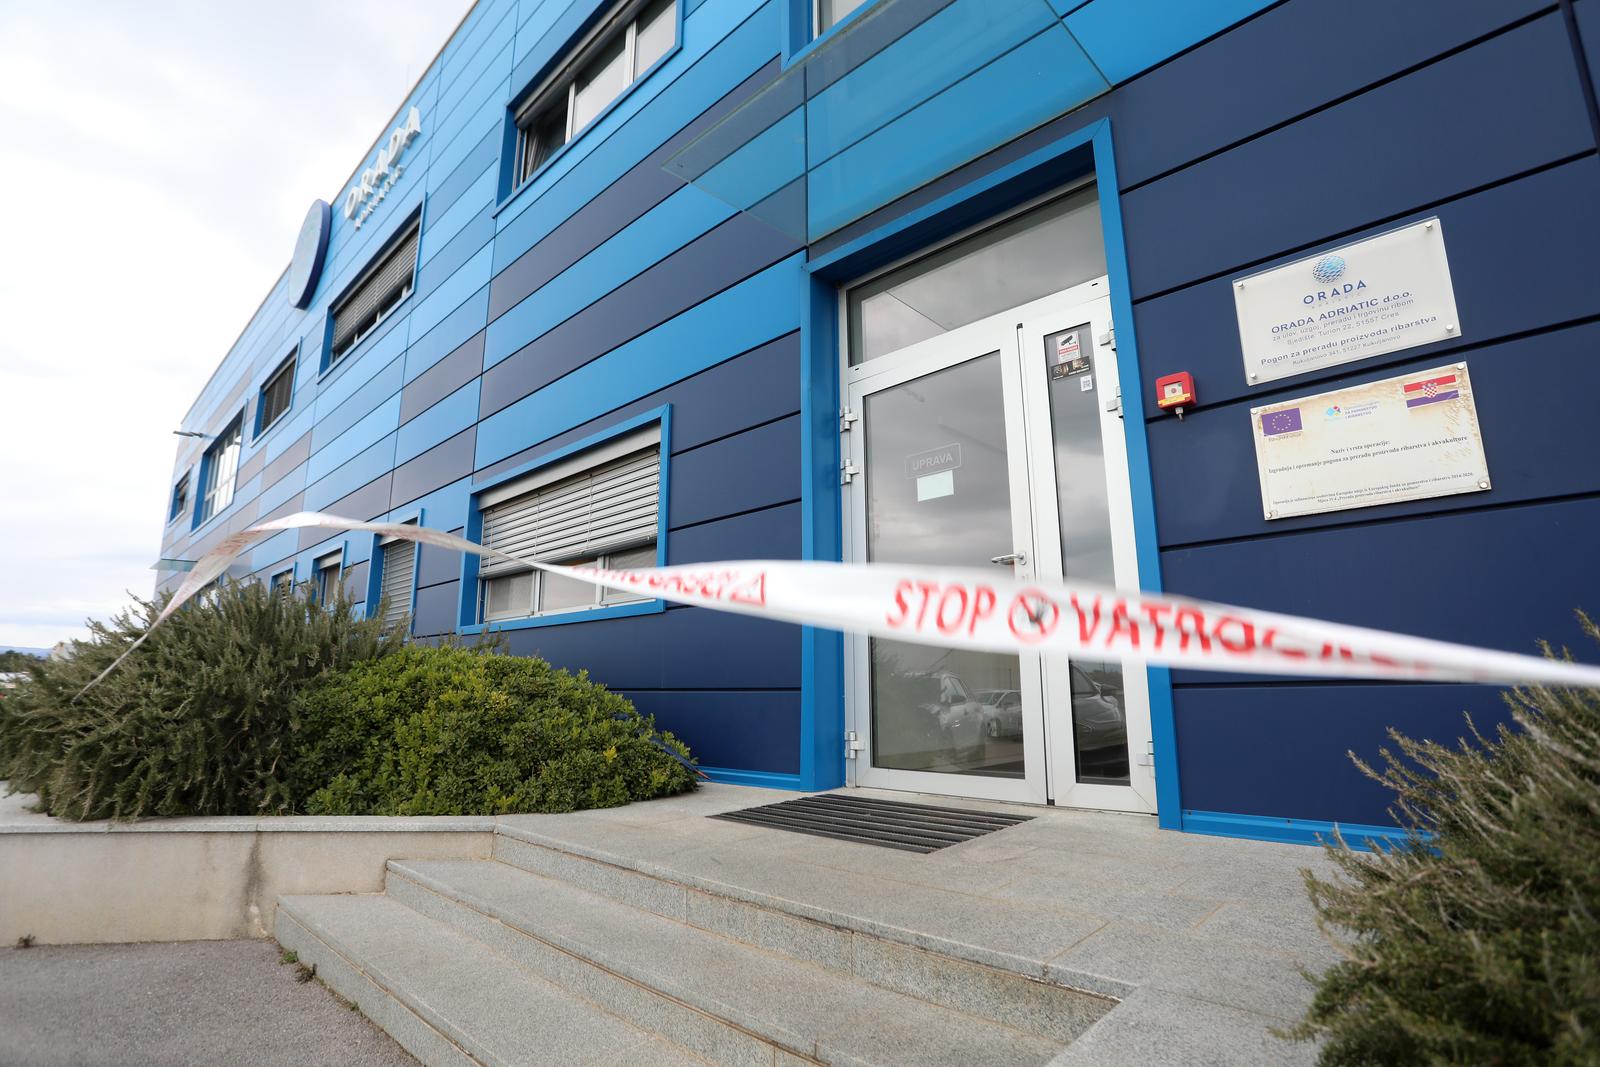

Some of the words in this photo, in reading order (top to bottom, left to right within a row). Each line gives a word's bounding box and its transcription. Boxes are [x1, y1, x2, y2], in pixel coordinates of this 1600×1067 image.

[1303, 280, 1367, 304] ORADA
[1271, 316, 1315, 334] ORADA
[1319, 298, 1379, 321] ADRIATIC
[1383, 291, 1413, 303] d.o.o.
[1323, 314, 1352, 328] preradu
[1358, 305, 1390, 319] trgovinu
[1391, 298, 1414, 310] ribom
[1260, 352, 1289, 366] Pogon
[1290, 350, 1301, 358] za
[1302, 340, 1338, 356] preradu
[1340, 327, 1389, 346] proizvoda
[1390, 315, 1437, 333] ribarstva
[912, 452, 954, 471] UPRAVA
[886, 578, 995, 638] STOP
